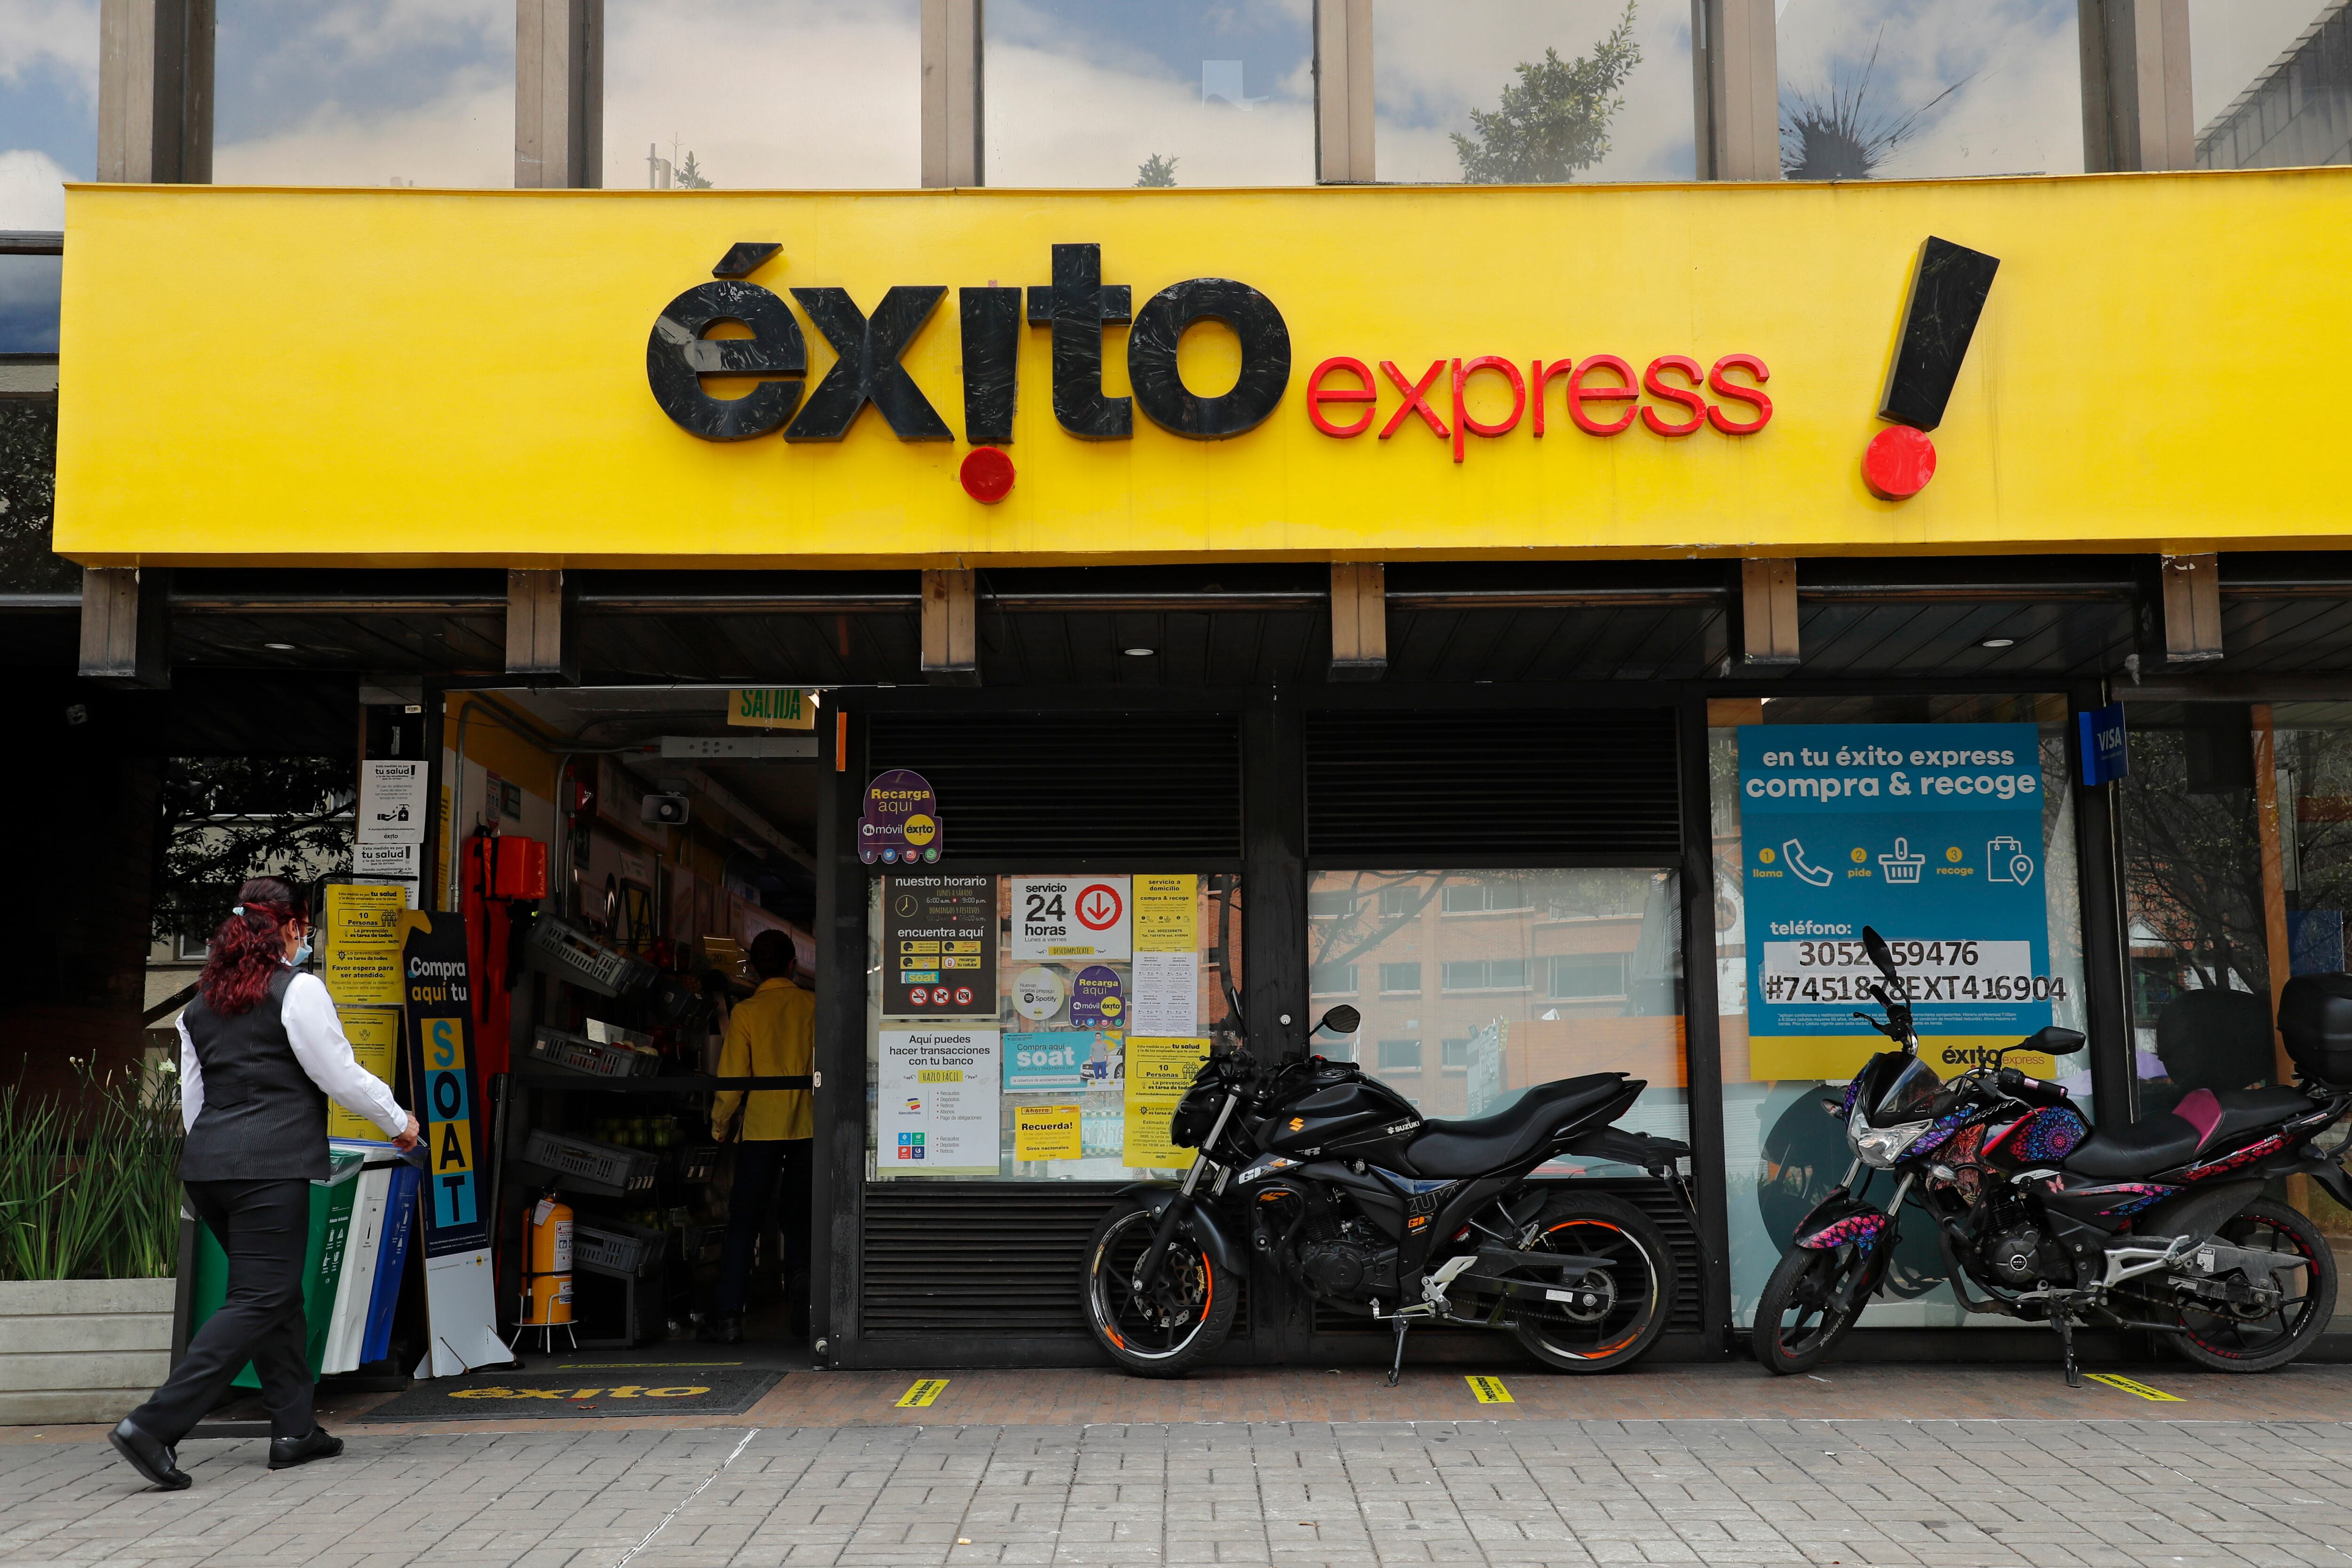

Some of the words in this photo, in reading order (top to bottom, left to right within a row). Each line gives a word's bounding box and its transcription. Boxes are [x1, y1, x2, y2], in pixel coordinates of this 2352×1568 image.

[647, 242, 1291, 504] éxito
[1306, 353, 1773, 463] express
[741, 690, 801, 720] SALIDA
[2097, 727, 2122, 751] VISA
[1763, 752, 1794, 767] en
[1801, 748, 1828, 766] tu
[1836, 746, 1902, 766] éxito
[1910, 749, 2014, 767] express
[1746, 776, 1879, 802] compra
[1889, 772, 1912, 796] &
[1921, 774, 2035, 799] recoge
[871, 789, 930, 801] Recarga
[879, 798, 912, 814] aquí
[876, 825, 902, 834] móvil
[906, 825, 933, 836] éxito
[1764, 851, 1770, 861] 1
[1856, 851, 1862, 860] 2
[1951, 850, 1957, 860] 3
[1753, 869, 1782, 878] llama
[1848, 868, 1871, 878] pide
[1937, 867, 1973, 876] recoge
[896, 876, 940, 886] nuestro
[945, 876, 986, 886] horario
[1025, 883, 1067, 892] servicio
[1025, 894, 1066, 922] 24
[898, 927, 955, 937] encuentra
[959, 926, 984, 939] aquí
[1025, 923, 1066, 936] horas
[1770, 920, 1851, 935] teléfono:
[1800, 942, 1978, 966] 305259476
[411, 957, 466, 980] Compra
[909, 973, 936, 982] soat
[1079, 979, 1118, 987] Recarga
[412, 981, 446, 1005] aquí
[451, 983, 467, 1001] tu
[1083, 986, 1107, 996] aquí
[909, 1035, 931, 1045] Aquí
[934, 1035, 970, 1045] puedes
[890, 1046, 917, 1055] hacer
[943, 1057, 973, 1065] banco
[1017, 1047, 1074, 1067] soat
[2002, 1054, 2044, 1066] express
[923, 1072, 940, 1081] HAZLO
[943, 1070, 959, 1081] FÁCIL
[431, 1019, 466, 1223] SOAT
[1022, 1122, 1073, 1130] Recuerda!
[1395, 1121, 1420, 1132] SUZUKI
